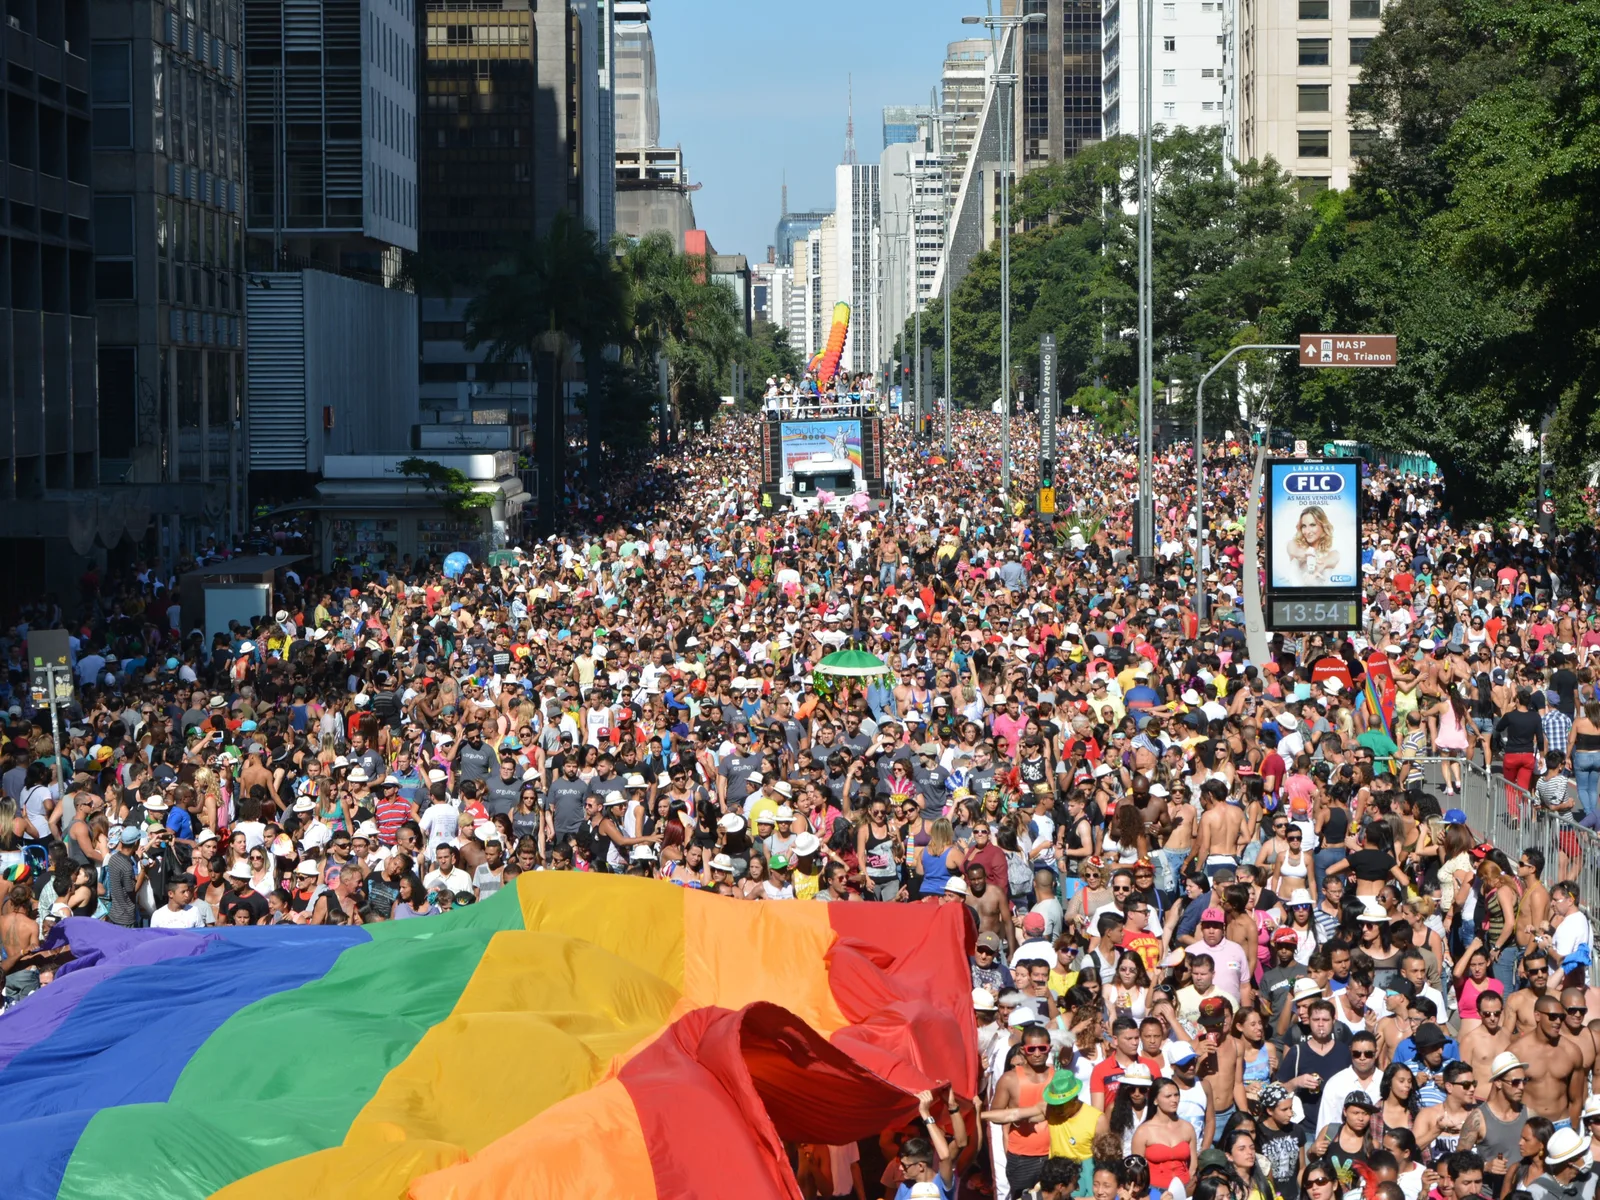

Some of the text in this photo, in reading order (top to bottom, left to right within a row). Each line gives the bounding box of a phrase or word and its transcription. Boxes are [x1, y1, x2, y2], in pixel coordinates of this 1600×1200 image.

[1336, 341, 1366, 349] MASP
[1336, 352, 1392, 362] Pq. Trianon
[1042, 354, 1051, 394] Azevedo
[1042, 397, 1051, 426] Rocha
[1042, 447, 1051, 460] Al.
[1297, 476, 1331, 491] FLC
[1282, 603, 1339, 622] 13:54
[495, 788, 516, 796] orgulho
[557, 788, 578, 796] orgulho
